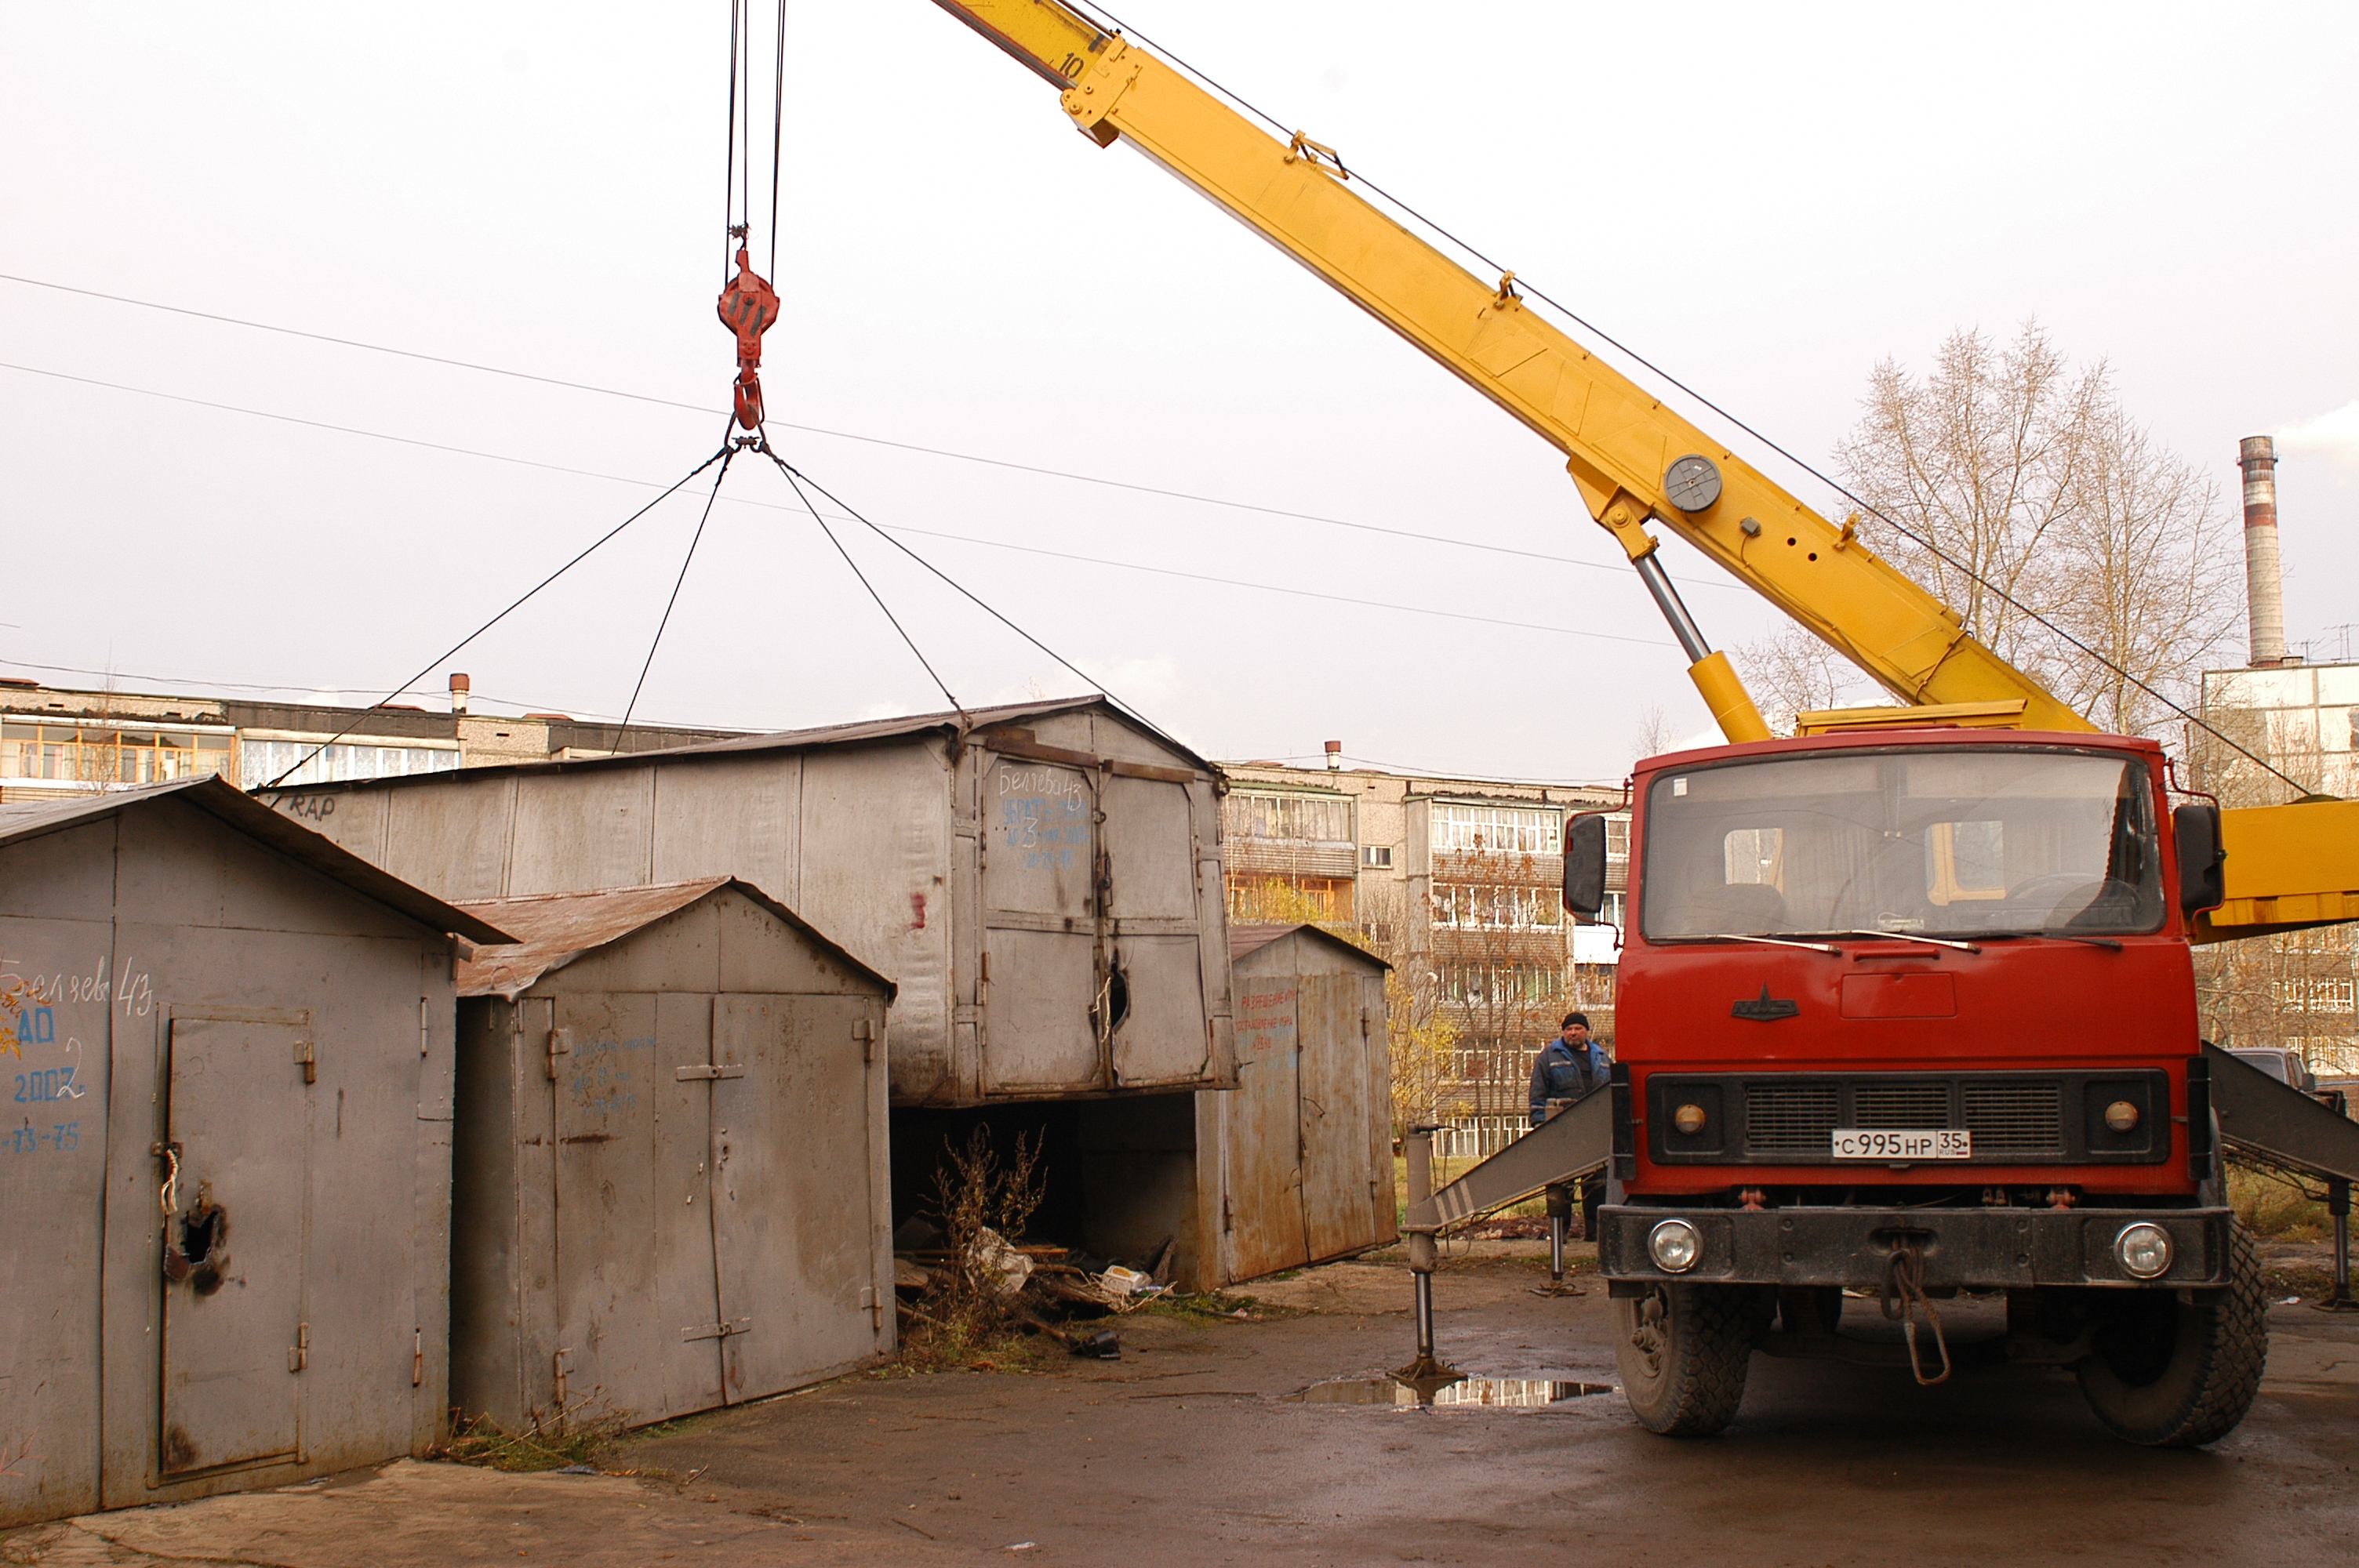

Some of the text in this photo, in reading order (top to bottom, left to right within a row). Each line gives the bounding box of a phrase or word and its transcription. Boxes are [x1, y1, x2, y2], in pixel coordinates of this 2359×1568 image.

[1059, 52, 1085, 78] 10
[1841, 1133, 1962, 1156] С995НР 35
